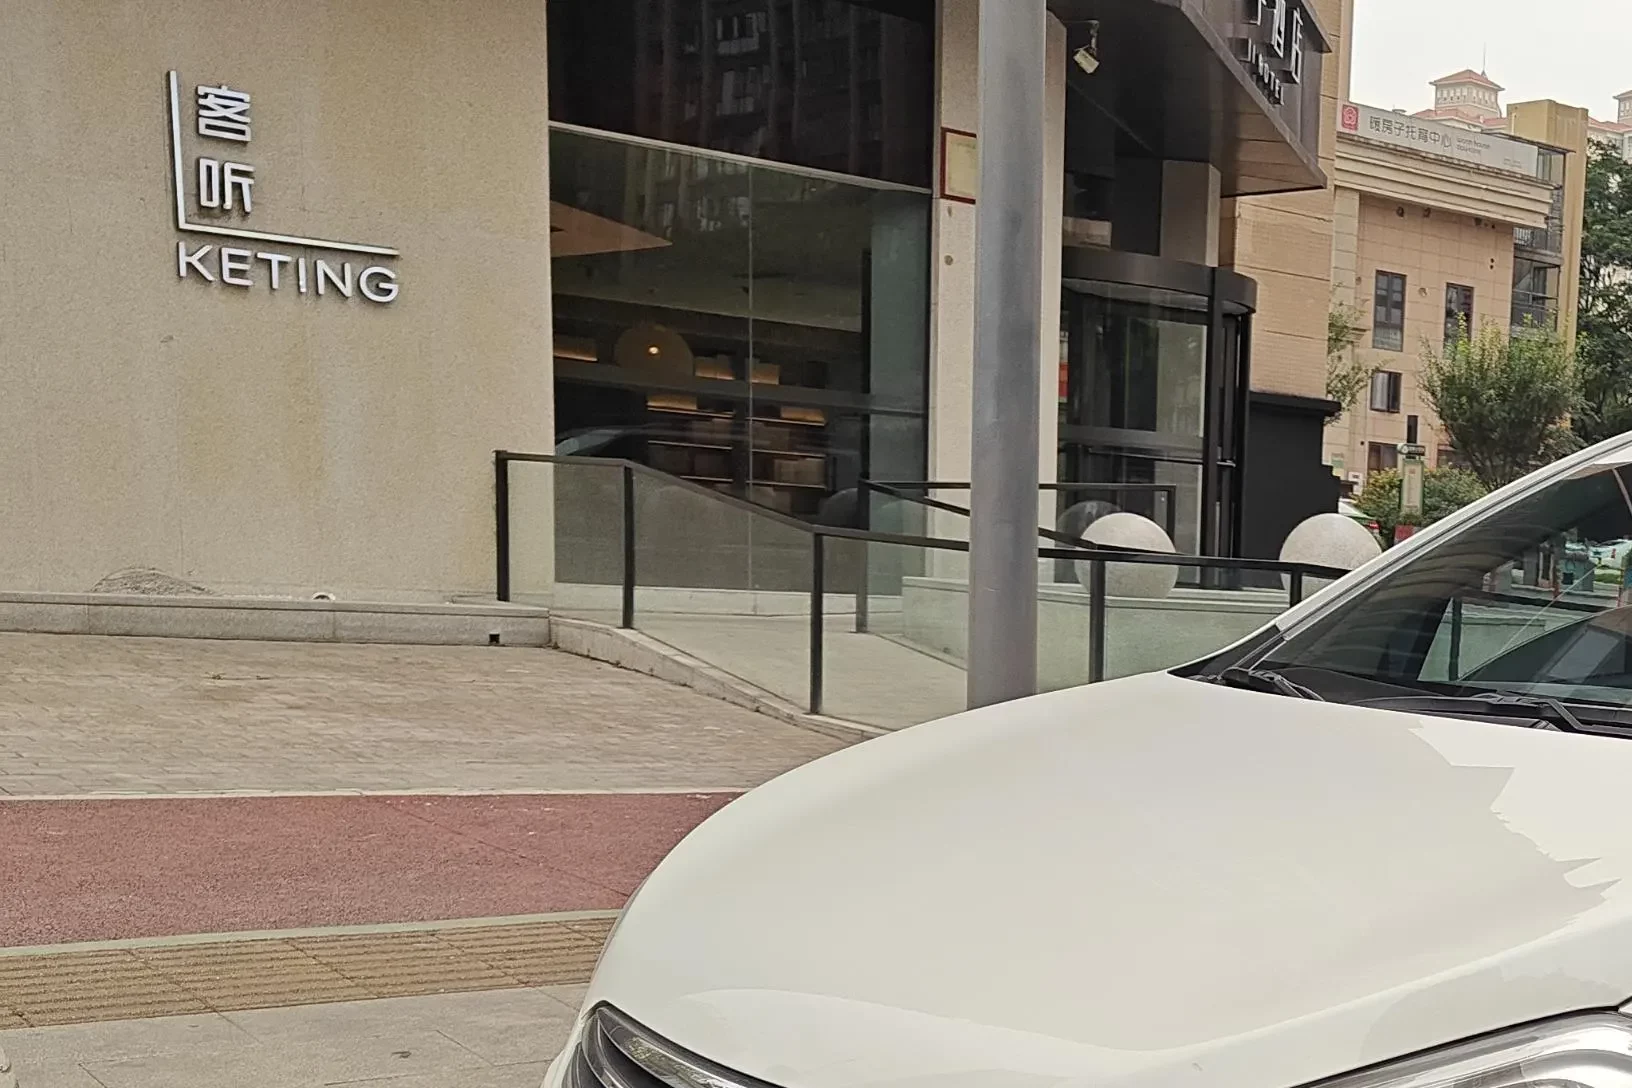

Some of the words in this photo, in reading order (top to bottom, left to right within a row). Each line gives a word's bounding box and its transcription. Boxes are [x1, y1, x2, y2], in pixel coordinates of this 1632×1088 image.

[1259, 53, 1285, 105] HOTEL
[197, 84, 255, 213] 客听
[178, 241, 399, 303] KETING
